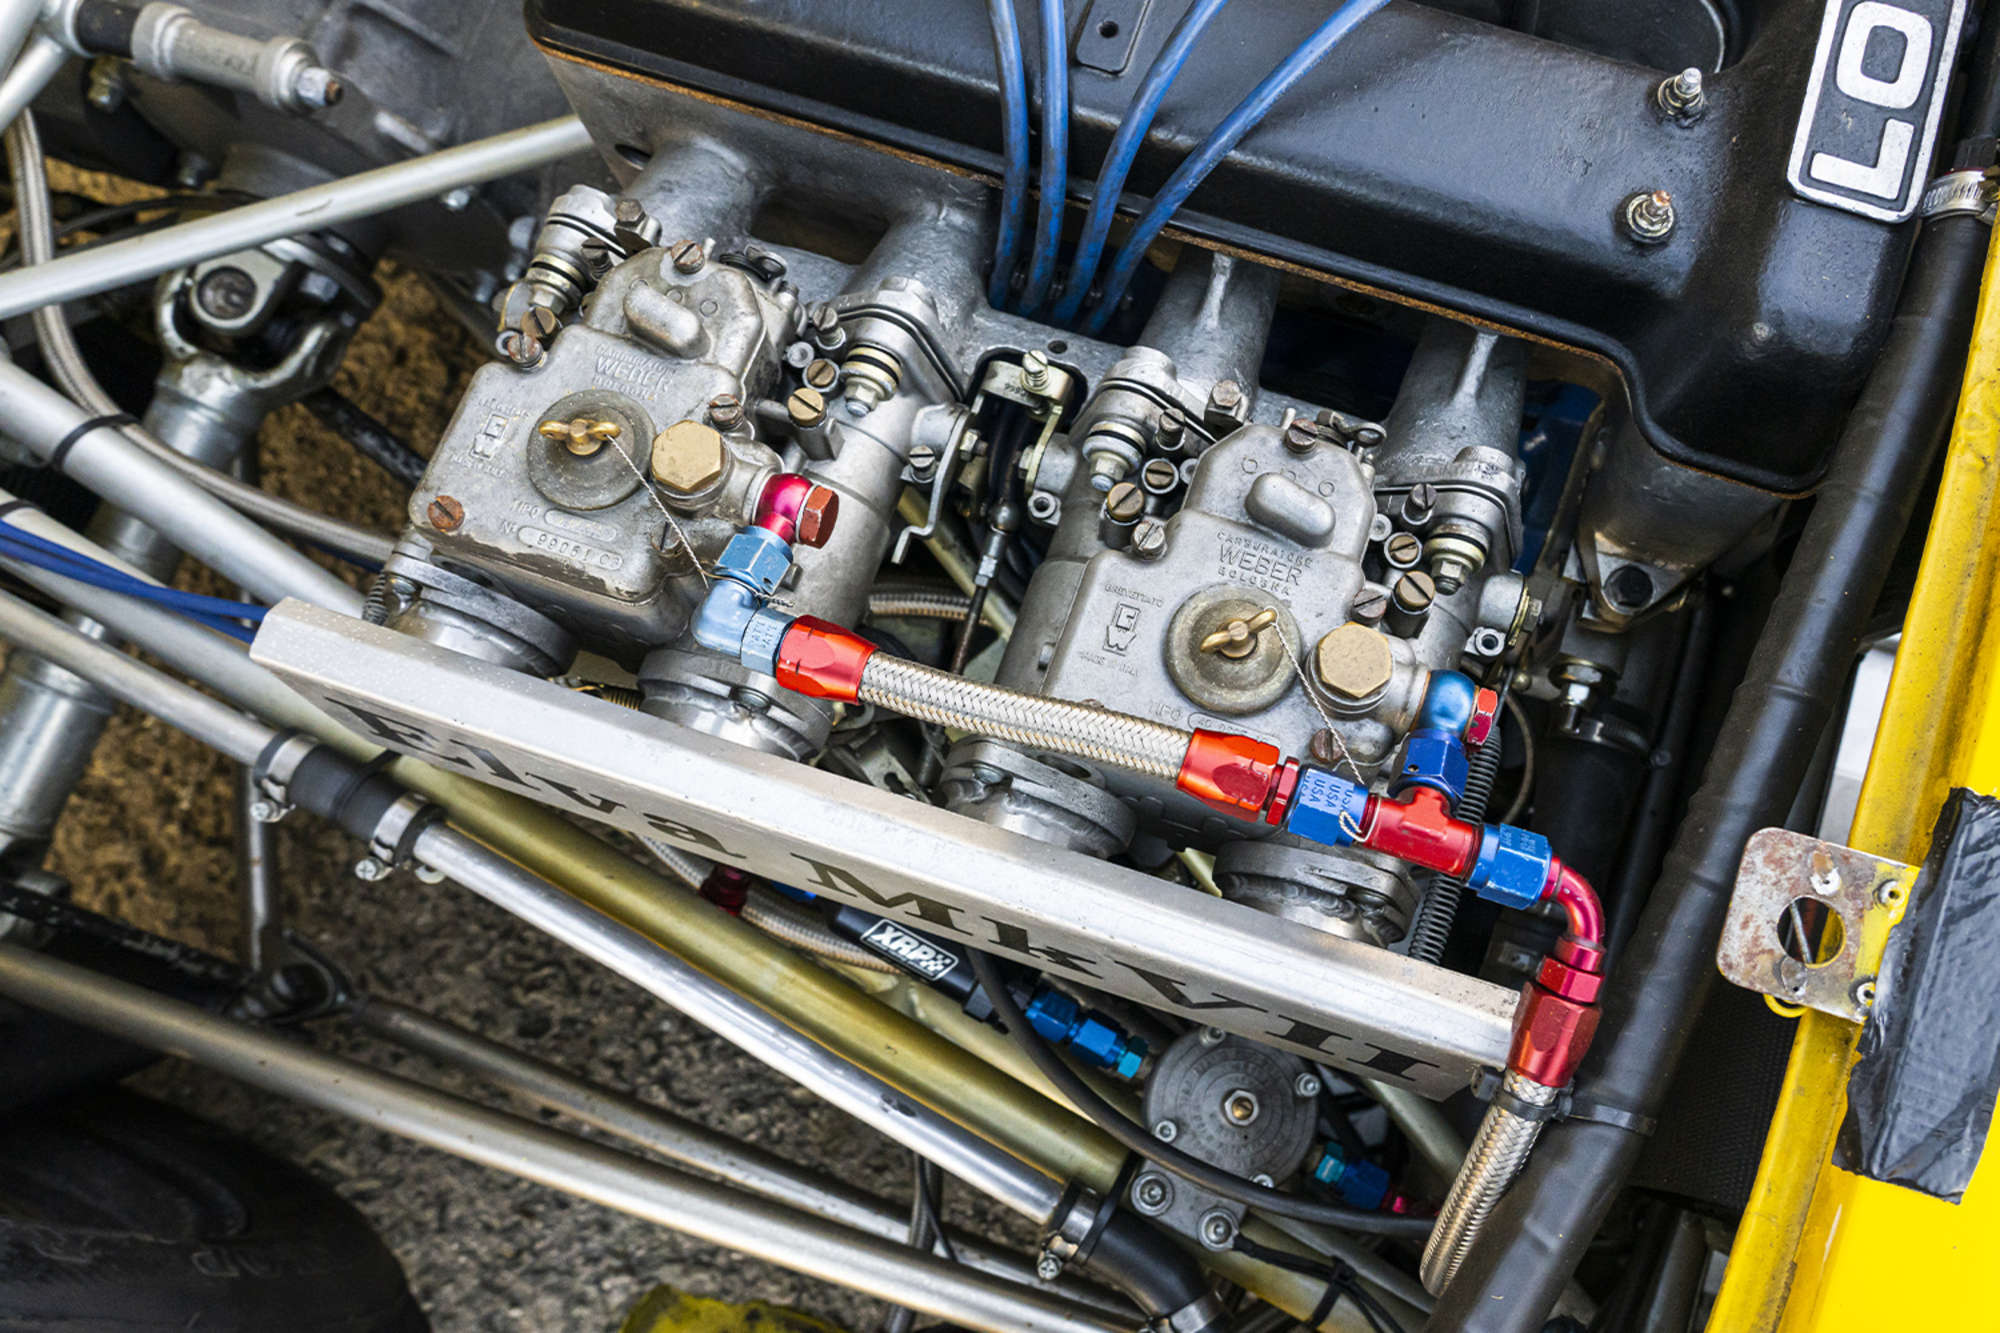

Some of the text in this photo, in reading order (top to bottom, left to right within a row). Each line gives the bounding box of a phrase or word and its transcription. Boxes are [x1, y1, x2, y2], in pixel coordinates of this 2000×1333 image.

[1219, 543, 1303, 586] WEBER
[1309, 779, 1326, 802] USA
[1325, 784, 1342, 808] USA
[867, 925, 937, 961] XRP
